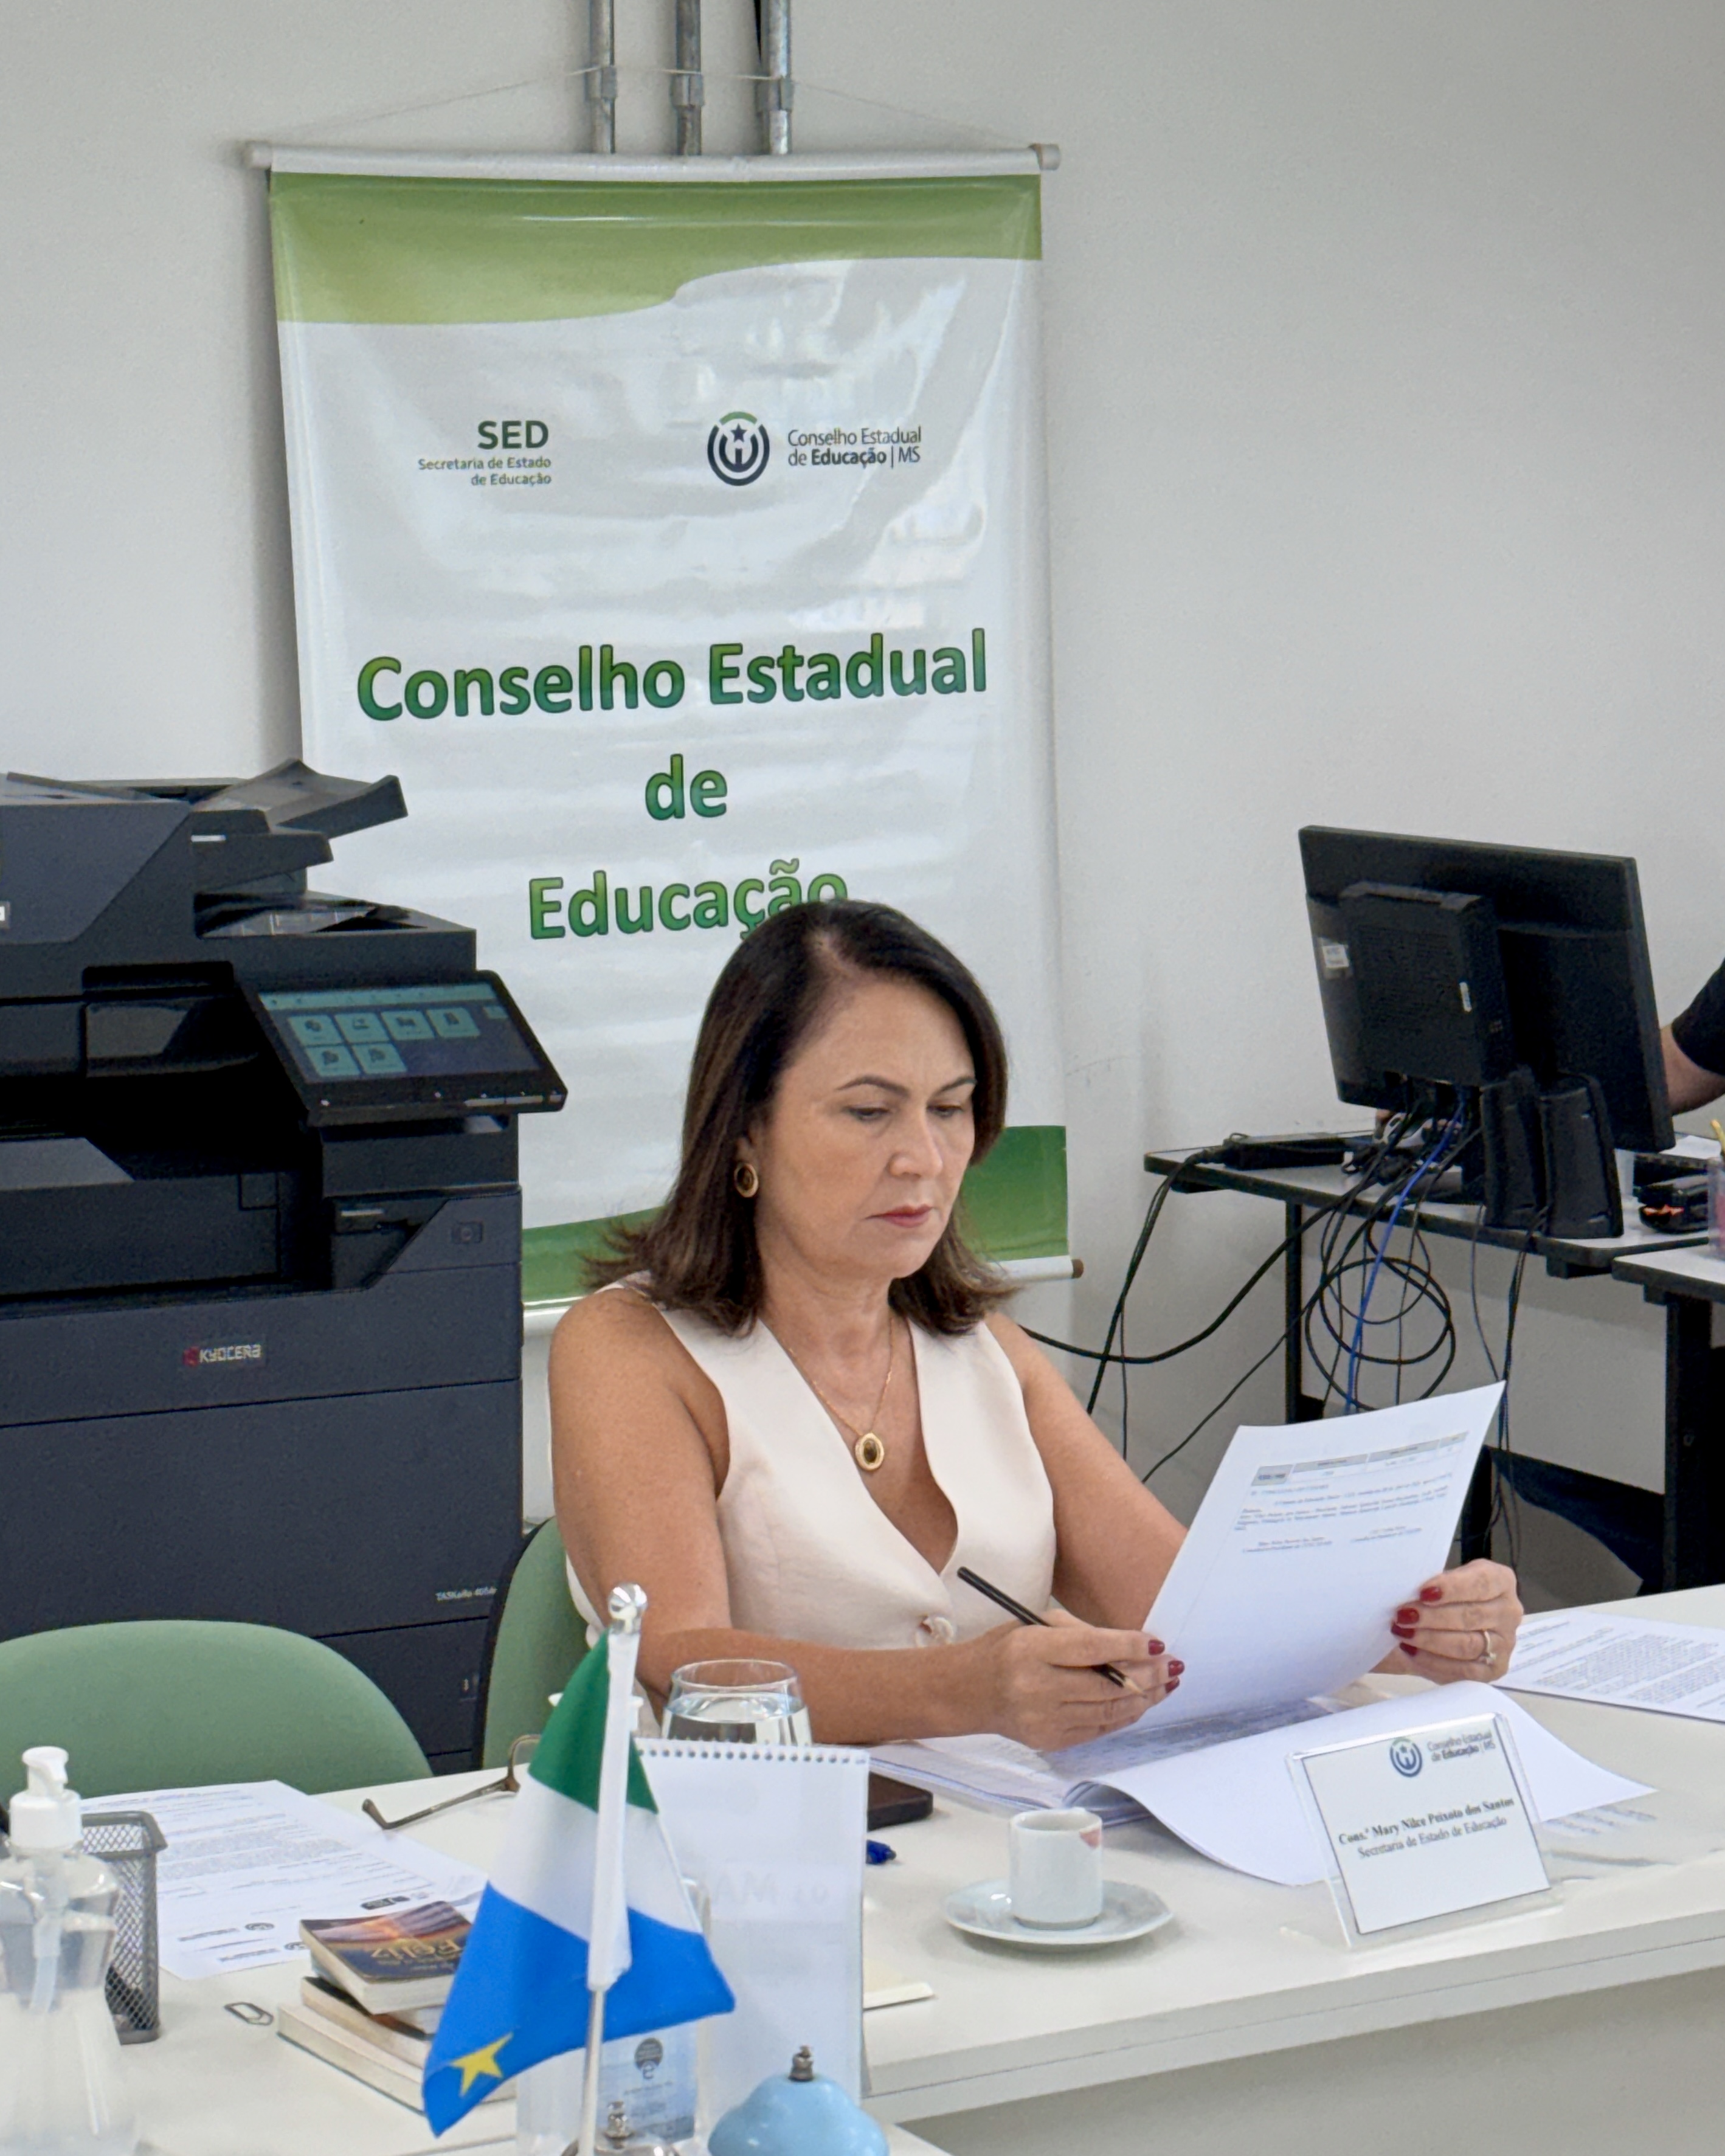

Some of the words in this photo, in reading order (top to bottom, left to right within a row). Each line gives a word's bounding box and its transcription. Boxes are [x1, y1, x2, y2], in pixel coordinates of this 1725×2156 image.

[478, 420, 548, 449] SED
[787, 427, 857, 446] Conselho
[861, 425, 921, 444] Estadual
[418, 458, 484, 471] Secretaria
[487, 456, 503, 469] de
[506, 455, 552, 469] Estado
[787, 448, 807, 467] de
[811, 446, 887, 468] Educação
[898, 445, 921, 464] MS
[471, 473, 486, 486] de
[490, 471, 552, 487] Educação
[357, 645, 685, 721] Conselho
[709, 628, 987, 705] Estadual
[645, 754, 728, 820] de
[199, 1344, 261, 1364] KYOCERA
[1442, 1744, 1480, 1760] Educação
[1372, 1824, 1400, 1836] Mary
[1428, 1808, 1464, 1825] Peixoto
[1465, 1804, 1482, 1816] dos
[1482, 1797, 1515, 1813] Santos
[1357, 1840, 1405, 1858] Secretaria
[1406, 1836, 1417, 1847] de
[1417, 1828, 1451, 1845] Estado
[1451, 1824, 1463, 1837] de
[1464, 1815, 1507, 1834] Educação
